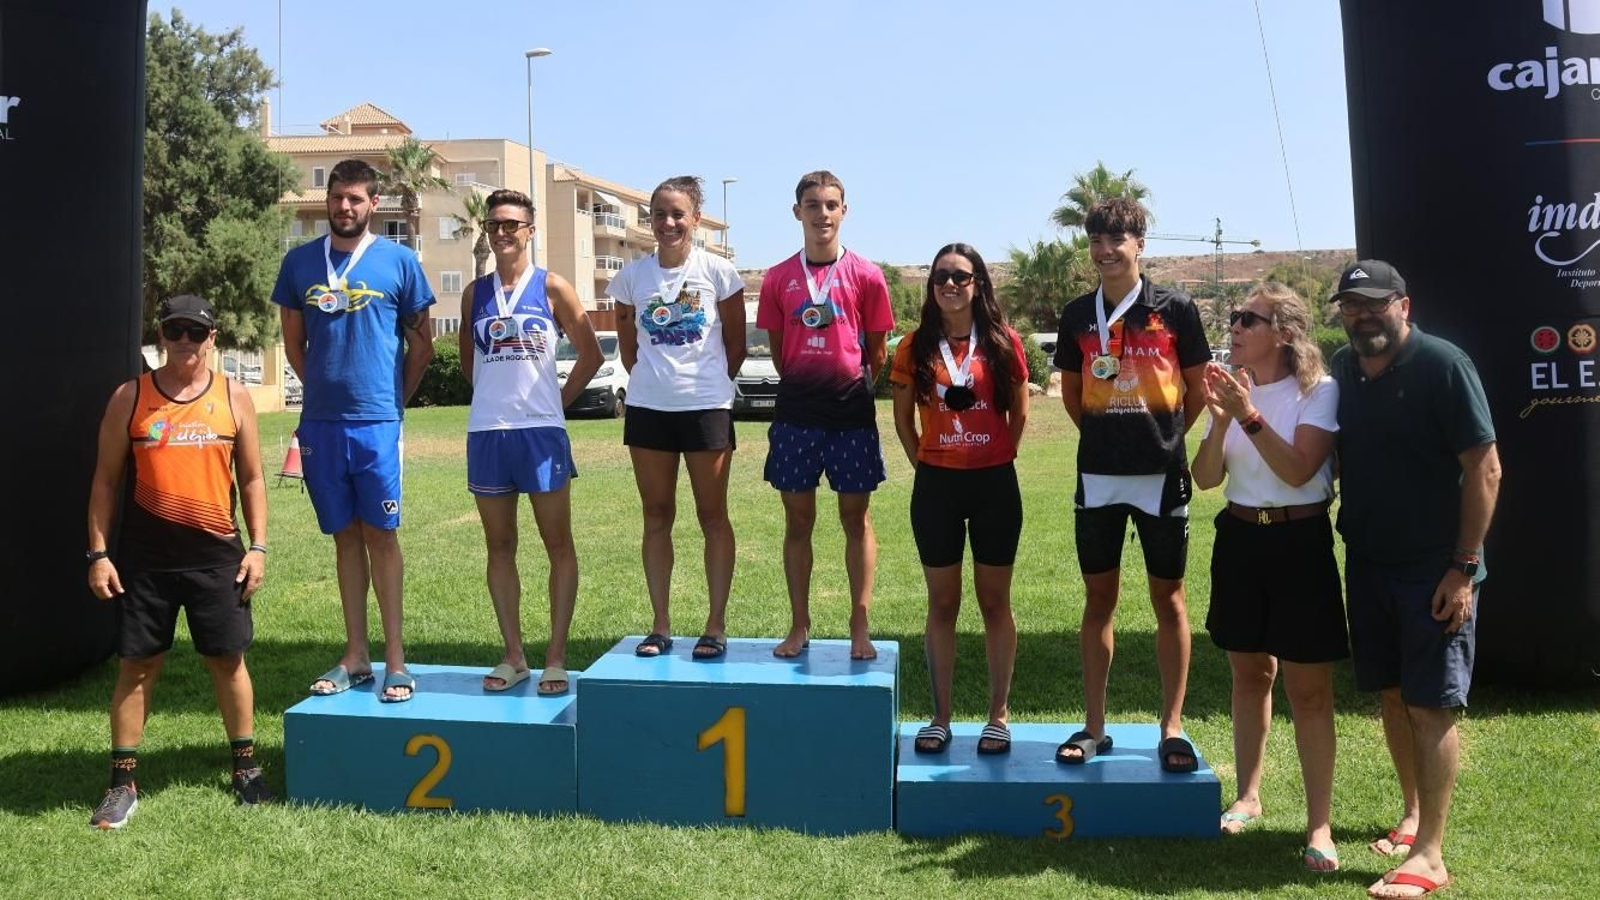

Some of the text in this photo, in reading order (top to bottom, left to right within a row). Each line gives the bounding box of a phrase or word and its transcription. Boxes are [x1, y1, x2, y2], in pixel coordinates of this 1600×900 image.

[1556, 268, 1596, 278] Instituto
[1531, 361, 1569, 390] EL
[404, 733, 454, 809] 2
[697, 707, 747, 818] 1
[1043, 793, 1075, 839] 3
